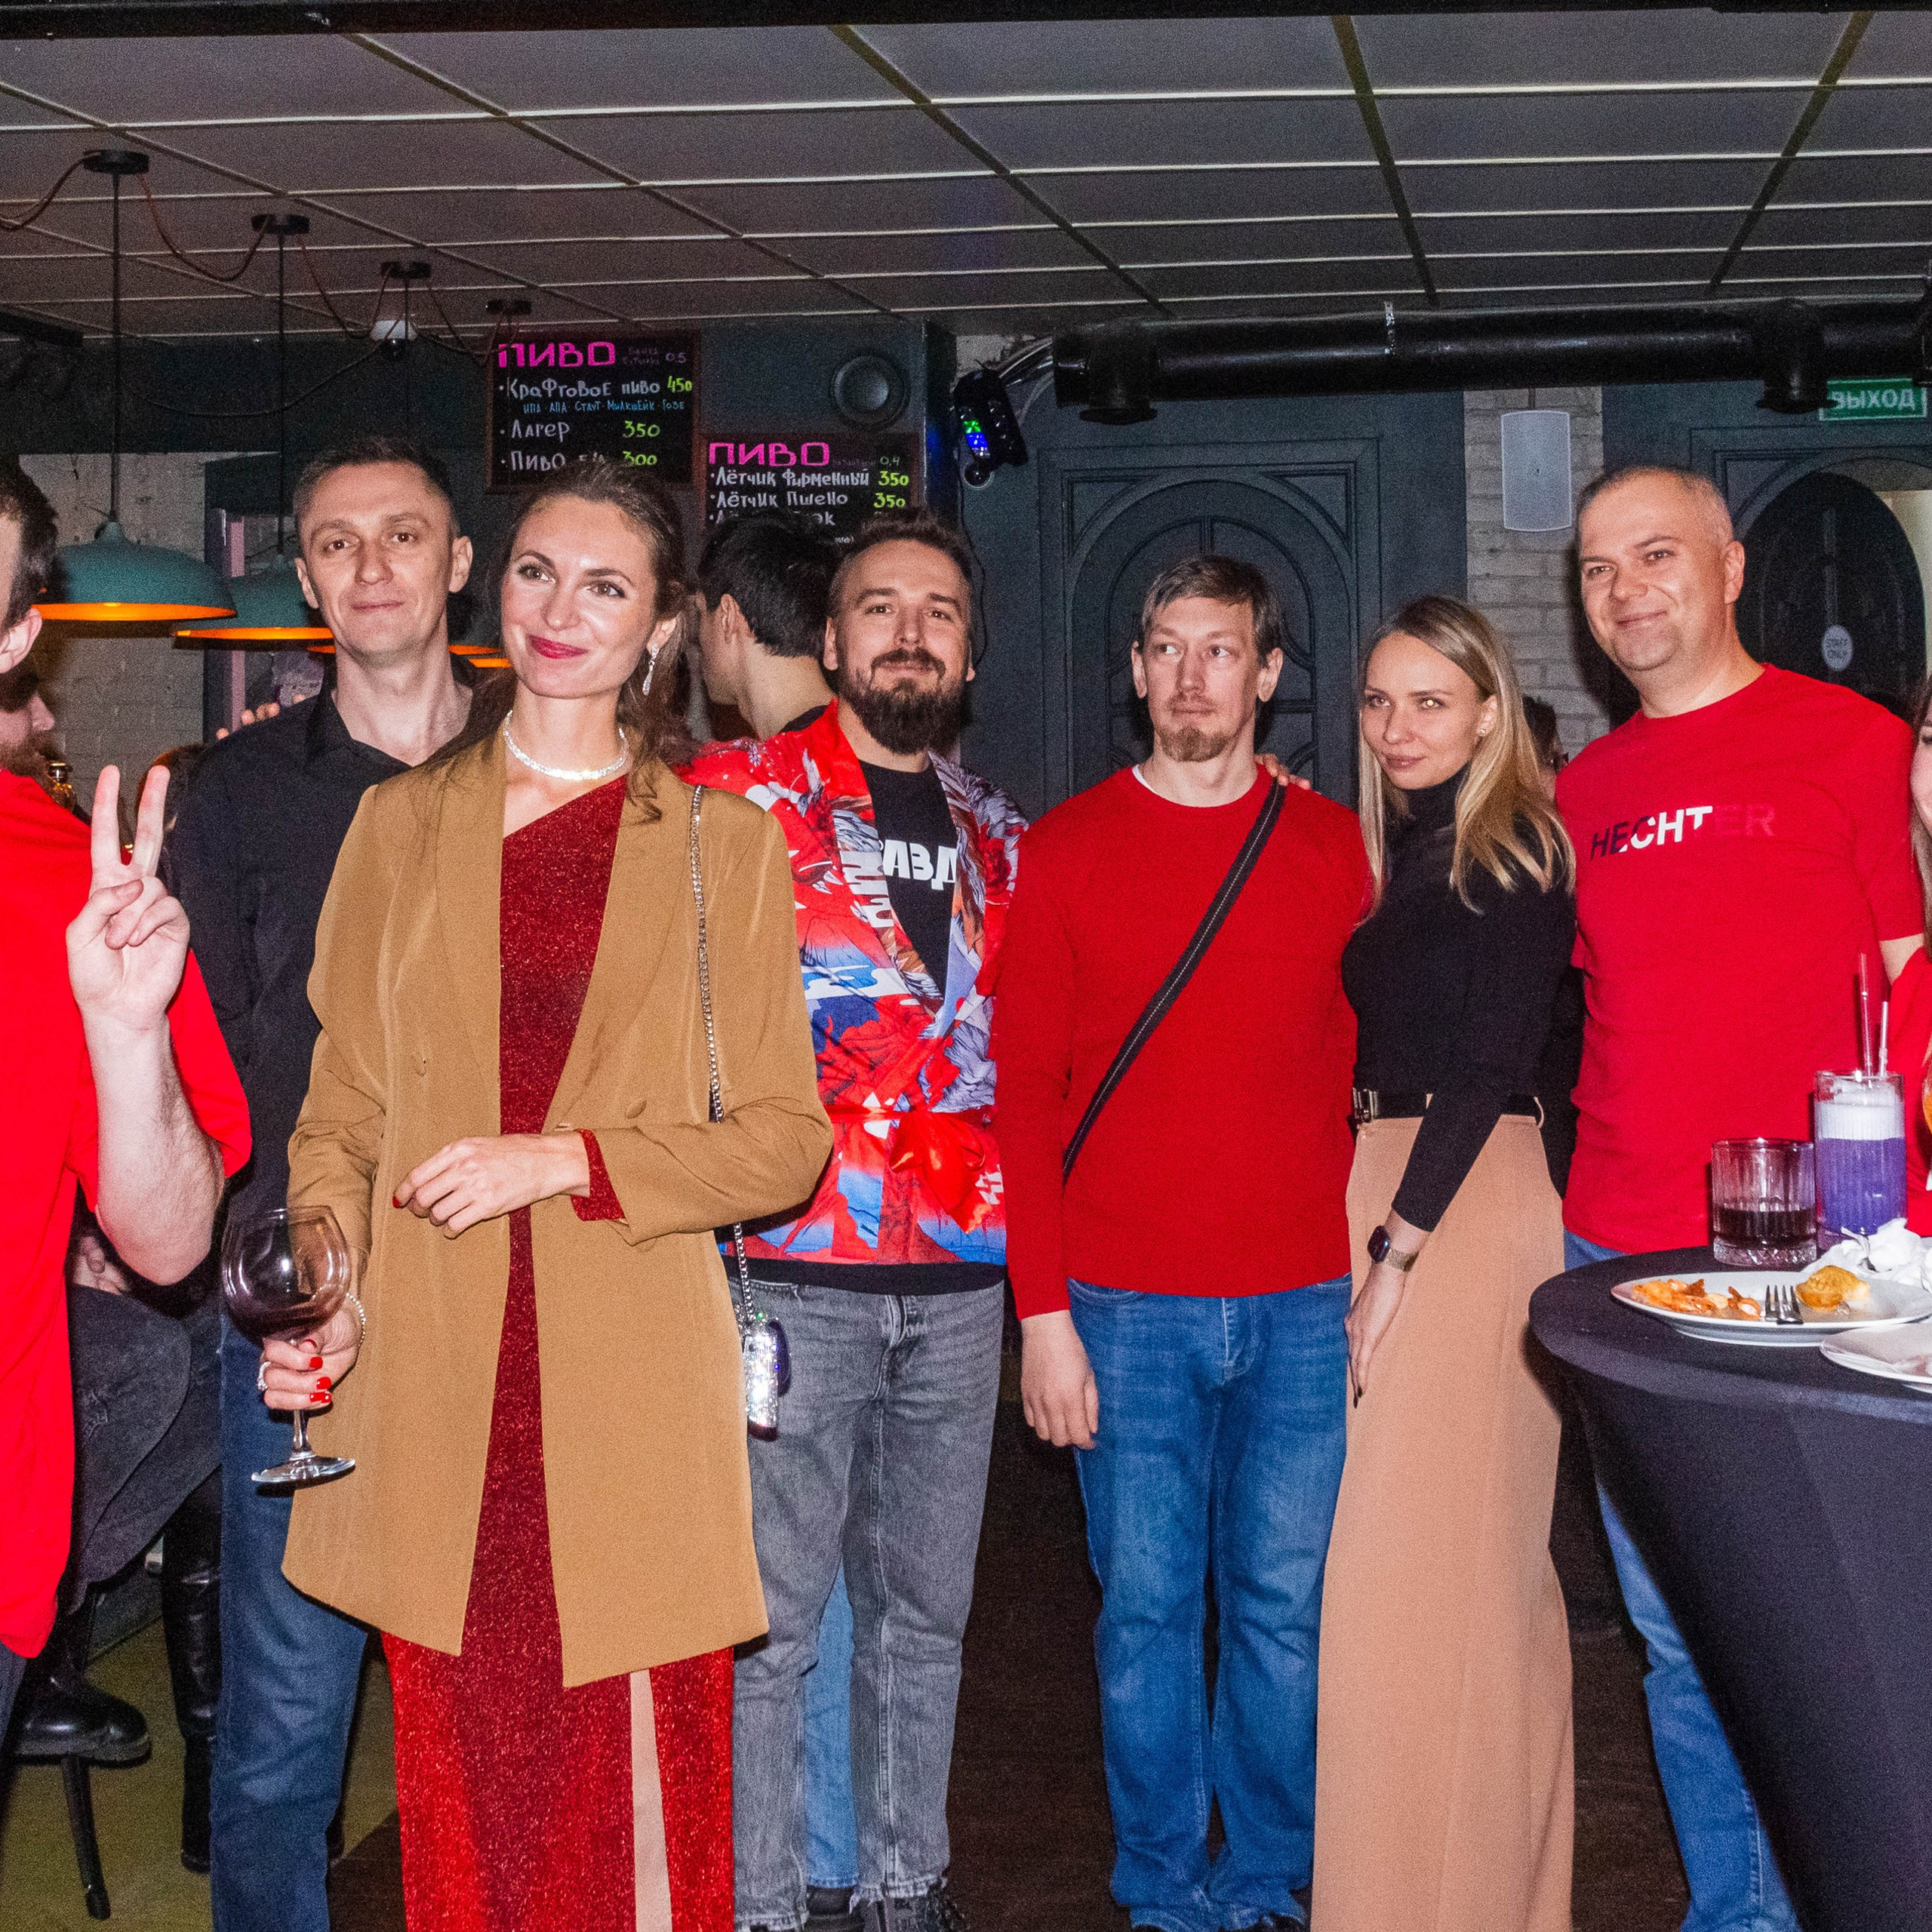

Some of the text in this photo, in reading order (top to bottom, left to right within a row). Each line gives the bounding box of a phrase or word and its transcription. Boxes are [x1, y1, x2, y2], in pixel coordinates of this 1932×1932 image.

[498, 342, 616, 368] ПИВО
[667, 376, 693, 393] 450
[623, 420, 661, 438] 350
[623, 451, 657, 466] 300
[709, 441, 829, 467] ПИВО
[878, 470, 909, 486] 350
[873, 493, 906, 509] 350
